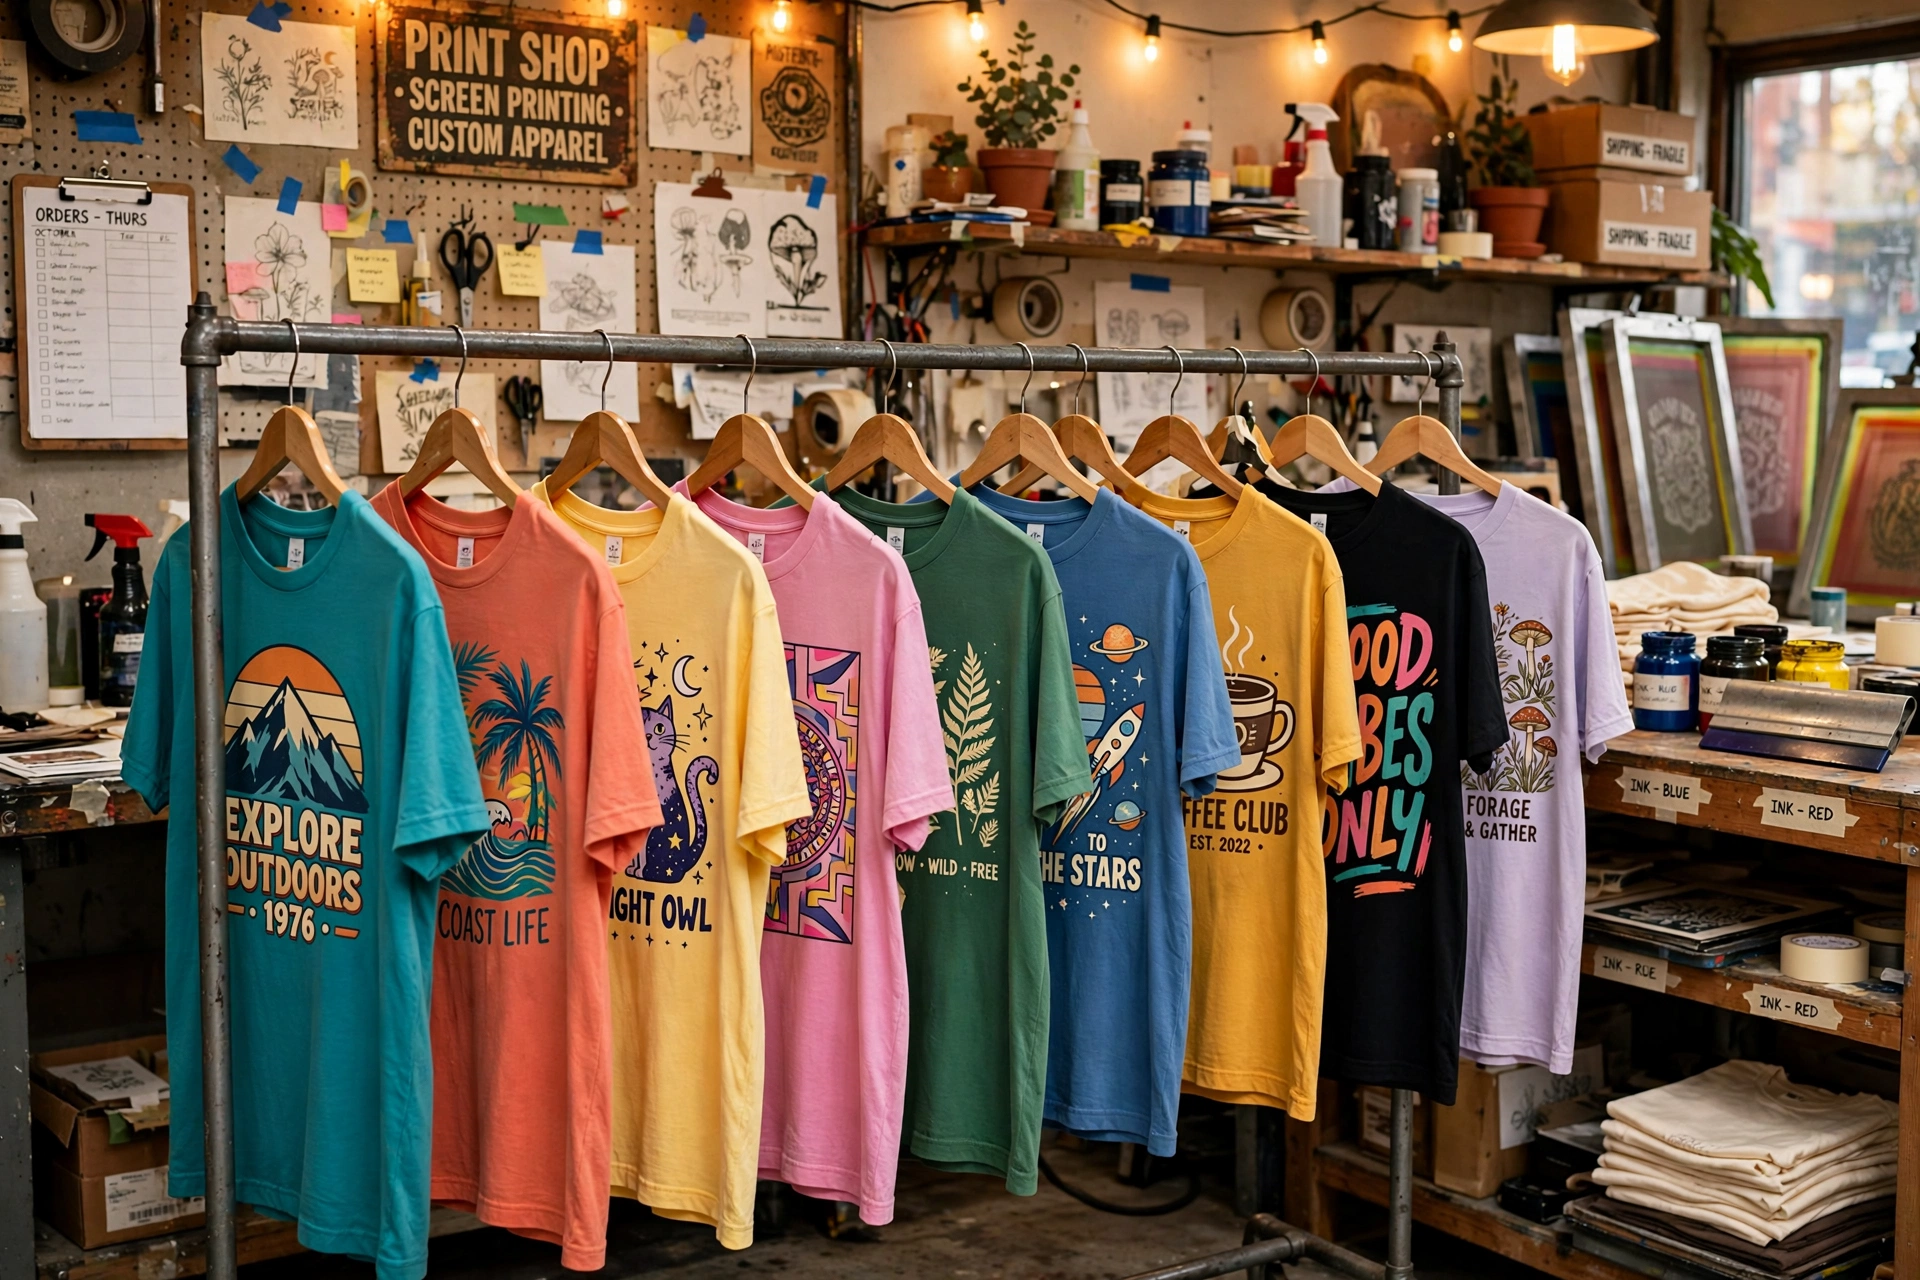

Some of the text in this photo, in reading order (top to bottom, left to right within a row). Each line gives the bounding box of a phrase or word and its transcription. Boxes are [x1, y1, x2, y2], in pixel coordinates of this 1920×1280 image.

[405, 19, 610, 87] PRINT SHOP
[409, 77, 611, 127] SCREEN PRINTING
[408, 117, 609, 164] CUSTOM APPAREL
[35, 207, 89, 224] ORDERS
[106, 211, 148, 226] THURS
[1350, 612, 1433, 691] OOD
[1348, 692, 1434, 787] BES
[1467, 795, 1531, 819] FORAGE
[1630, 778, 1651, 794] INK
[1663, 783, 1690, 799] BLUE
[1182, 797, 1288, 836] FFEE CLUB
[1771, 800, 1794, 816] INK
[1808, 805, 1834, 821] RED
[225, 796, 363, 868] EXPLORE
[1087, 833, 1107, 852] TO
[1190, 834, 1250, 854] EST. 2022
[1465, 820, 1537, 843] & GATHER
[227, 846, 363, 914] OUTDOORS
[896, 854, 999, 881] OW WILD FREE
[1070, 853, 1142, 891] STARS
[263, 899, 316, 944] 1976
[438, 899, 550, 947] COAST LIFE
[609, 886, 712, 932] IGHT OWL
[1602, 956, 1623, 971] INK
[1760, 995, 1782, 1011] INK
[1795, 1002, 1819, 1018] RED
